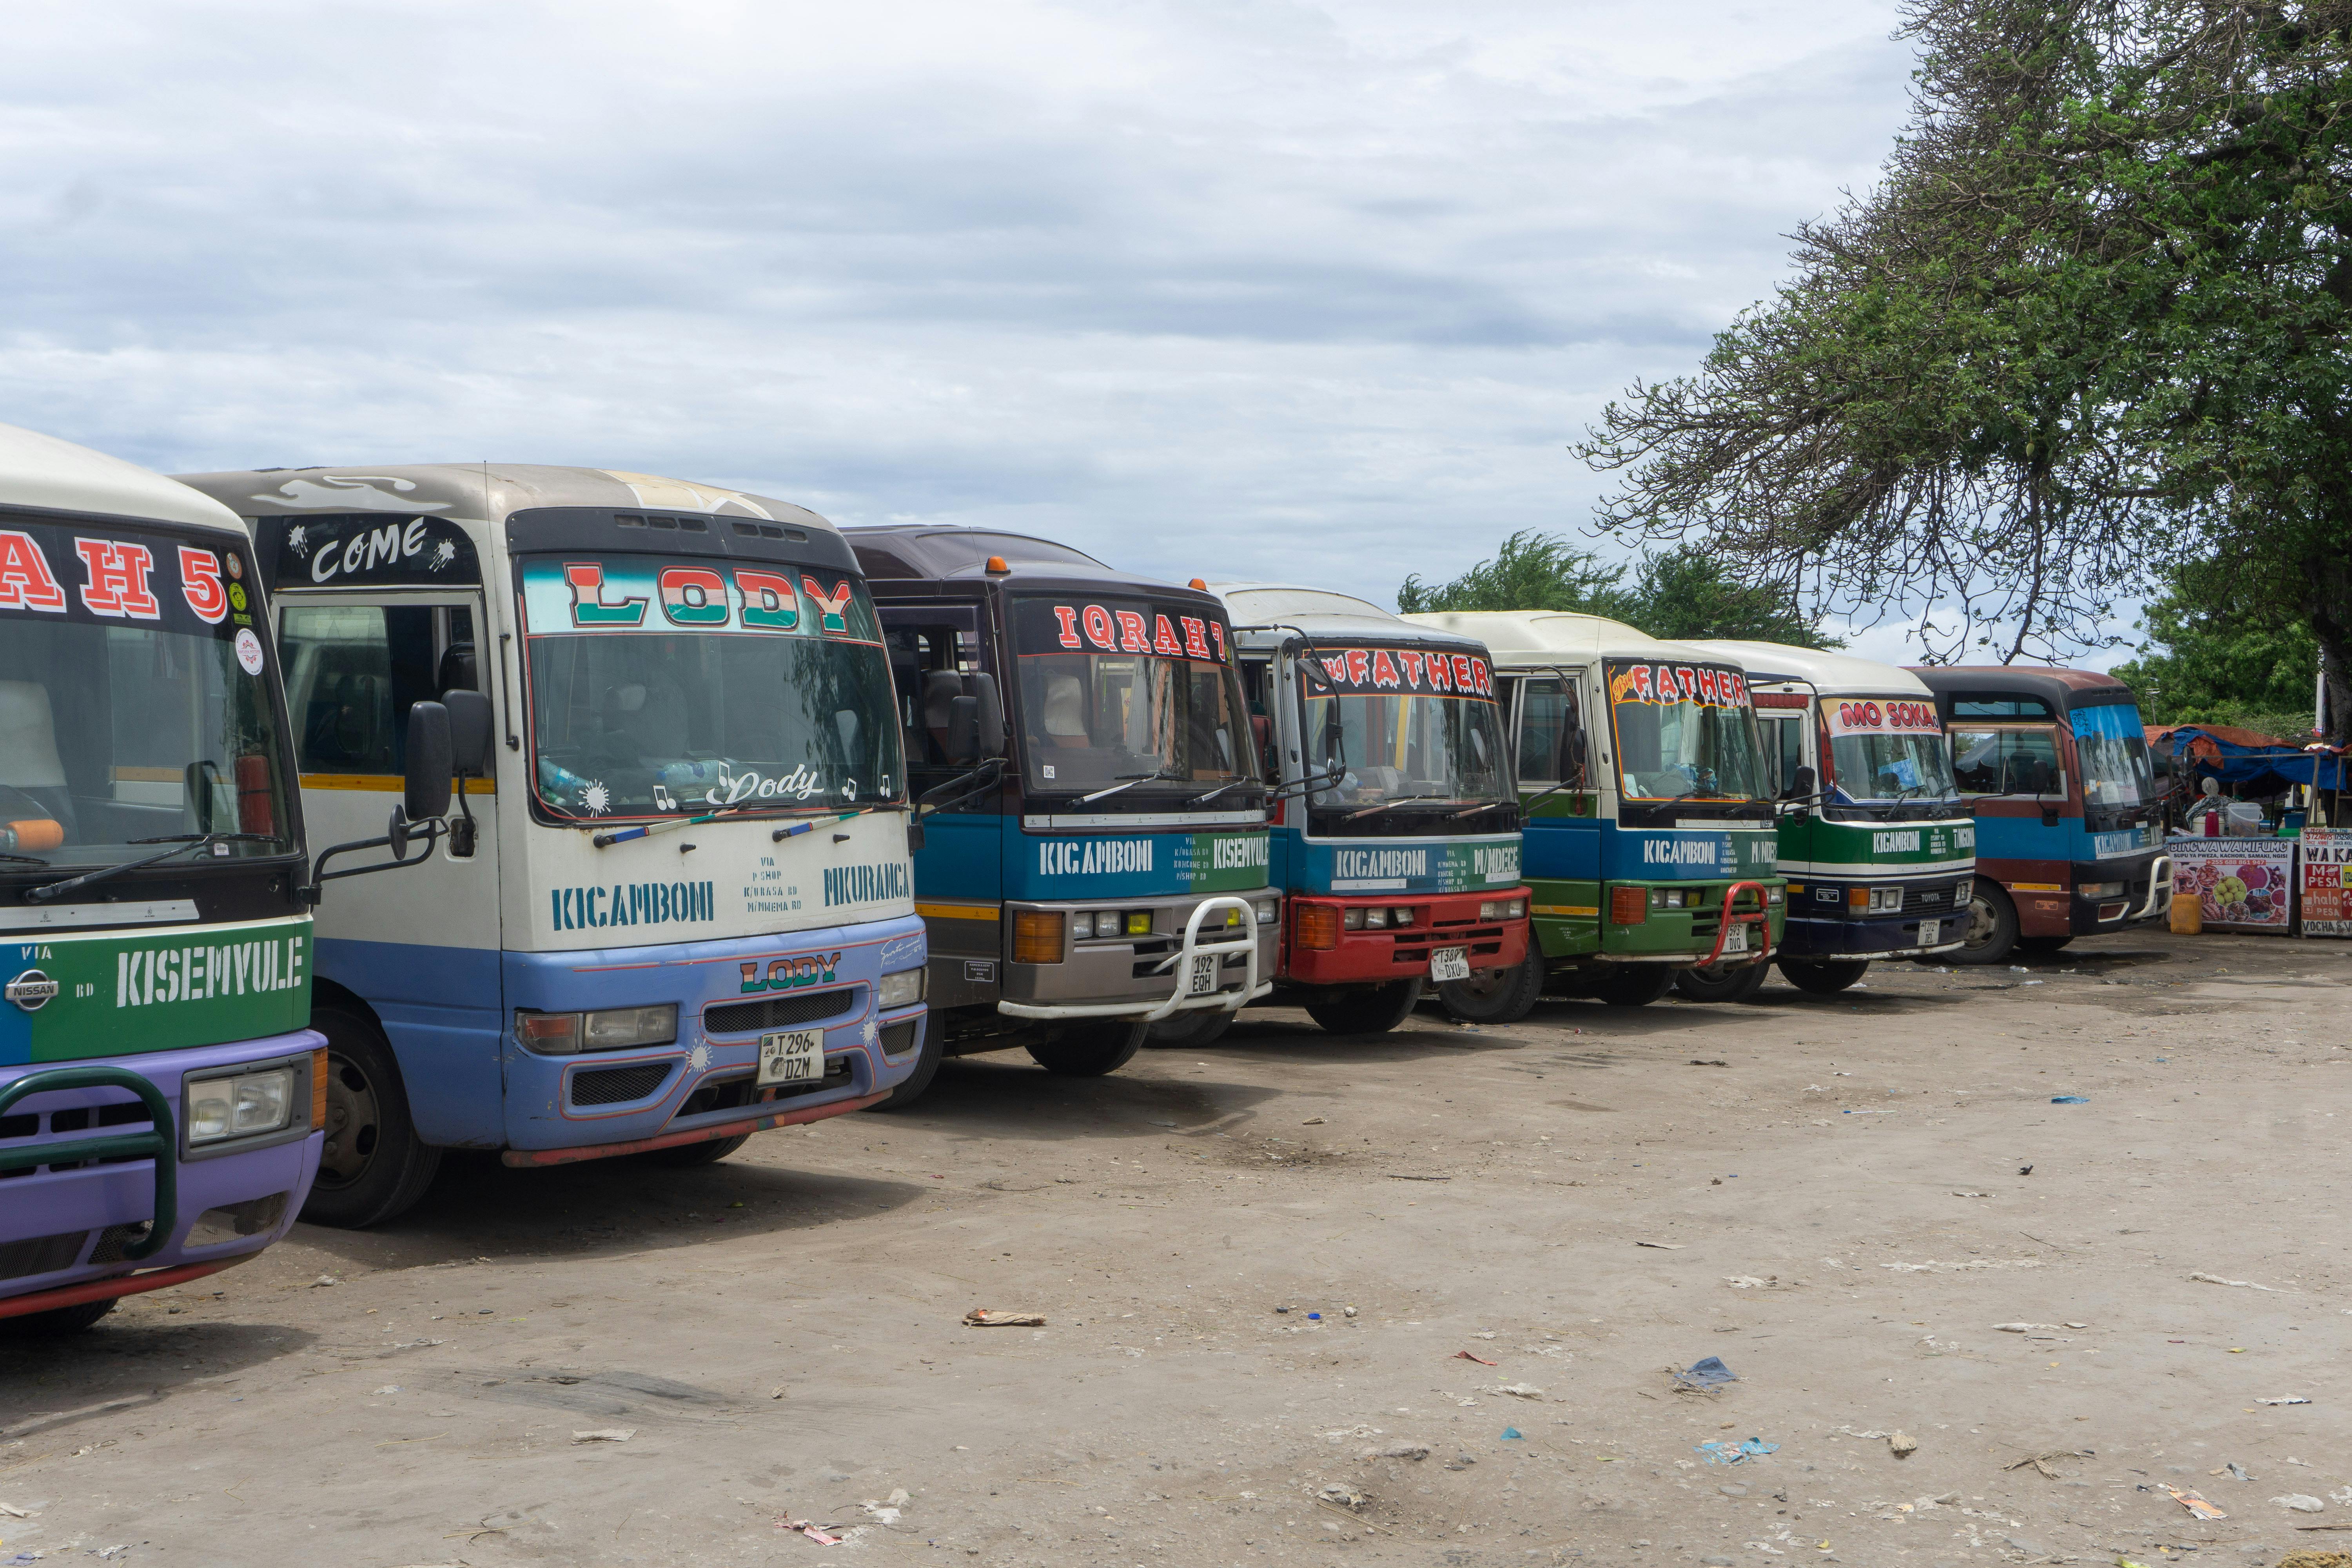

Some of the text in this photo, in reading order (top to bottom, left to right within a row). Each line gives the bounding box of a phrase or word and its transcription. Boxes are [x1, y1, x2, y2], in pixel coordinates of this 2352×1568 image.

[312, 517, 426, 583] COME
[178, 545, 227, 624] 5
[563, 562, 853, 635] LODY
[1054, 604, 1225, 662] IQRAH 7
[1345, 650, 1492, 696] FATHER
[1613, 665, 1747, 709] Big FATHER
[1840, 701, 1882, 729] MO
[706, 764, 824, 816] Dody
[1214, 837, 1269, 869] KISEMVULE
[1644, 840, 1715, 864] KIGAMBONI
[1873, 831, 1920, 853] KIGAMBONI
[2094, 832, 2132, 853] KIGAMBONI
[761, 857, 774, 866] VIA
[1040, 840, 1152, 875] KIGAMBONI
[1336, 850, 1426, 877] KIGAMBONI
[1474, 845, 1518, 874] M/NDEGE
[753, 871, 781, 882] P SHOP
[2312, 865, 2325, 876] M
[788, 886, 797, 895] RD
[824, 862, 910, 907] MKURANGA
[2308, 877, 2339, 887] PESA
[552, 881, 714, 931] KIGAMBONI
[792, 900, 801, 910] RD
[1922, 893, 1940, 902] TOYOTA
[2313, 891, 2338, 906] halo
[2317, 907, 2340, 916] PESA
[2302, 921, 2335, 932] VOCHA
[22, 946, 52, 960] VIA
[1730, 938, 1740, 950] DVQ
[117, 937, 303, 1007] KISEMVULE
[740, 952, 841, 993] LODY
[1194, 956, 1211, 974] 192
[1445, 963, 1461, 978] DXU
[14, 985, 54, 996] NISSAN
[1192, 974, 1210, 992] EQH
[785, 1057, 810, 1079] DZM
